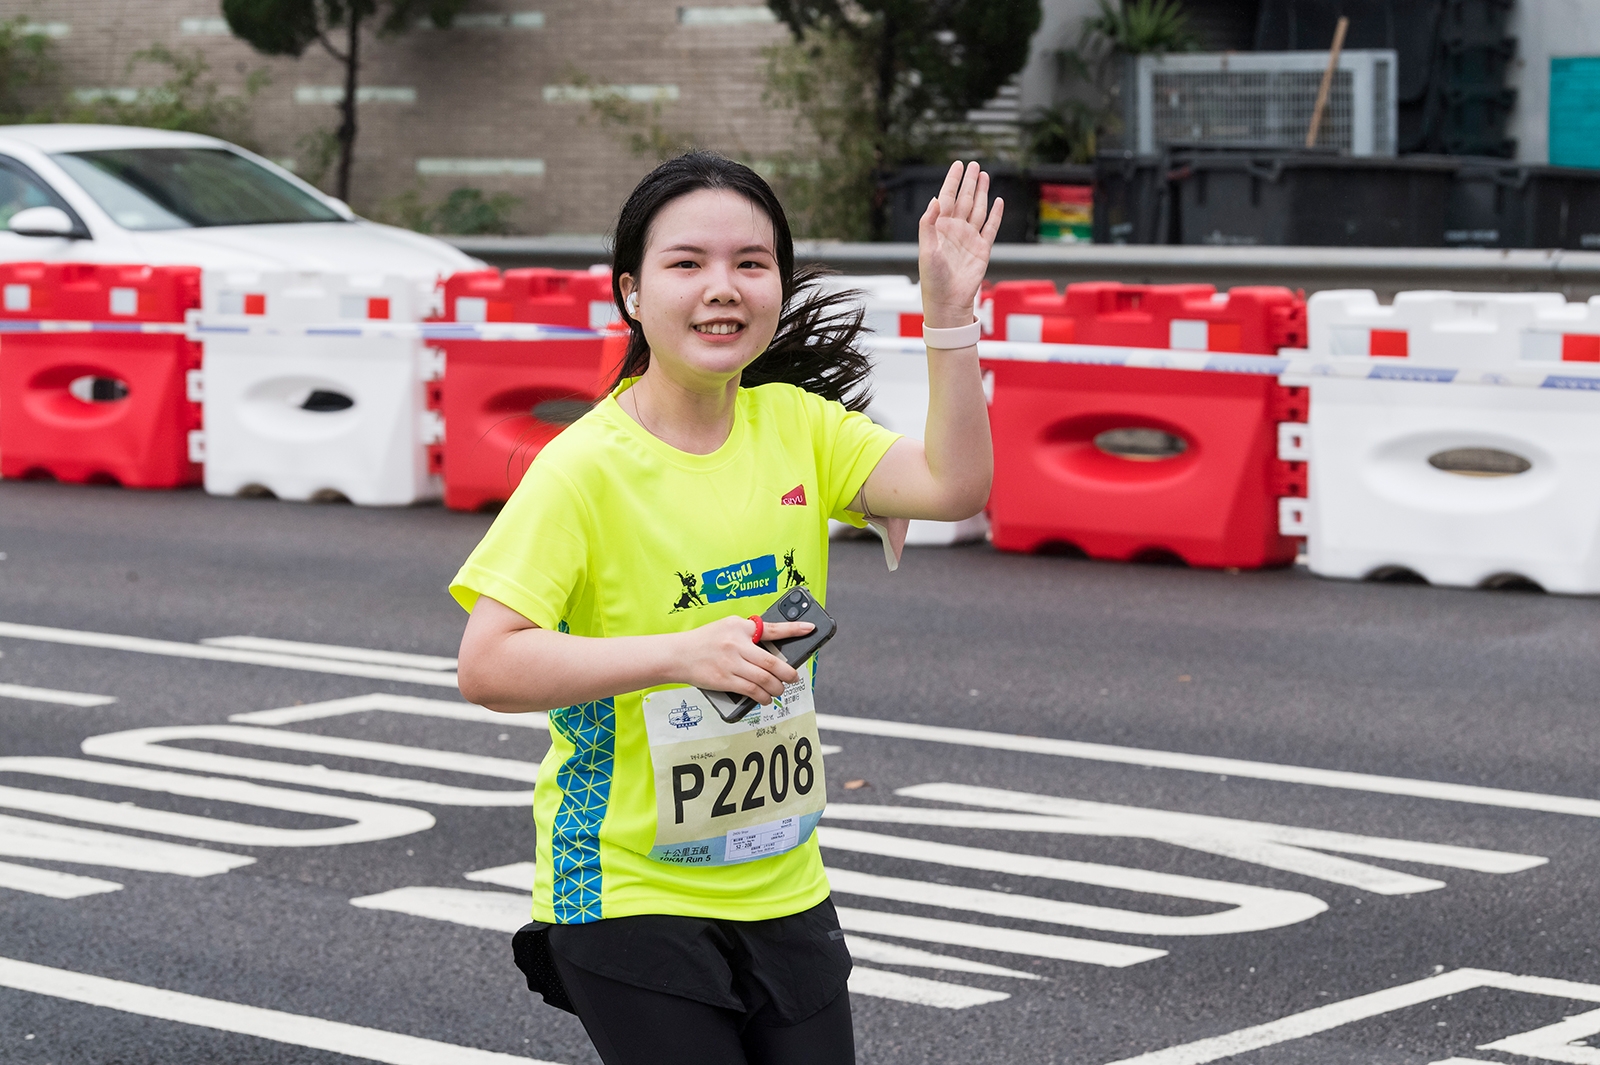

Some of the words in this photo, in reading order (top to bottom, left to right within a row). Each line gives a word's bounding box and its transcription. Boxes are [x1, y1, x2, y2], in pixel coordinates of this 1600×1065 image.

[783, 495, 803, 506] CityU
[716, 563, 752, 590] CityU
[726, 578, 770, 597] Runner
[672, 736, 814, 825] P2208
[663, 845, 709, 857] 十公里五組
